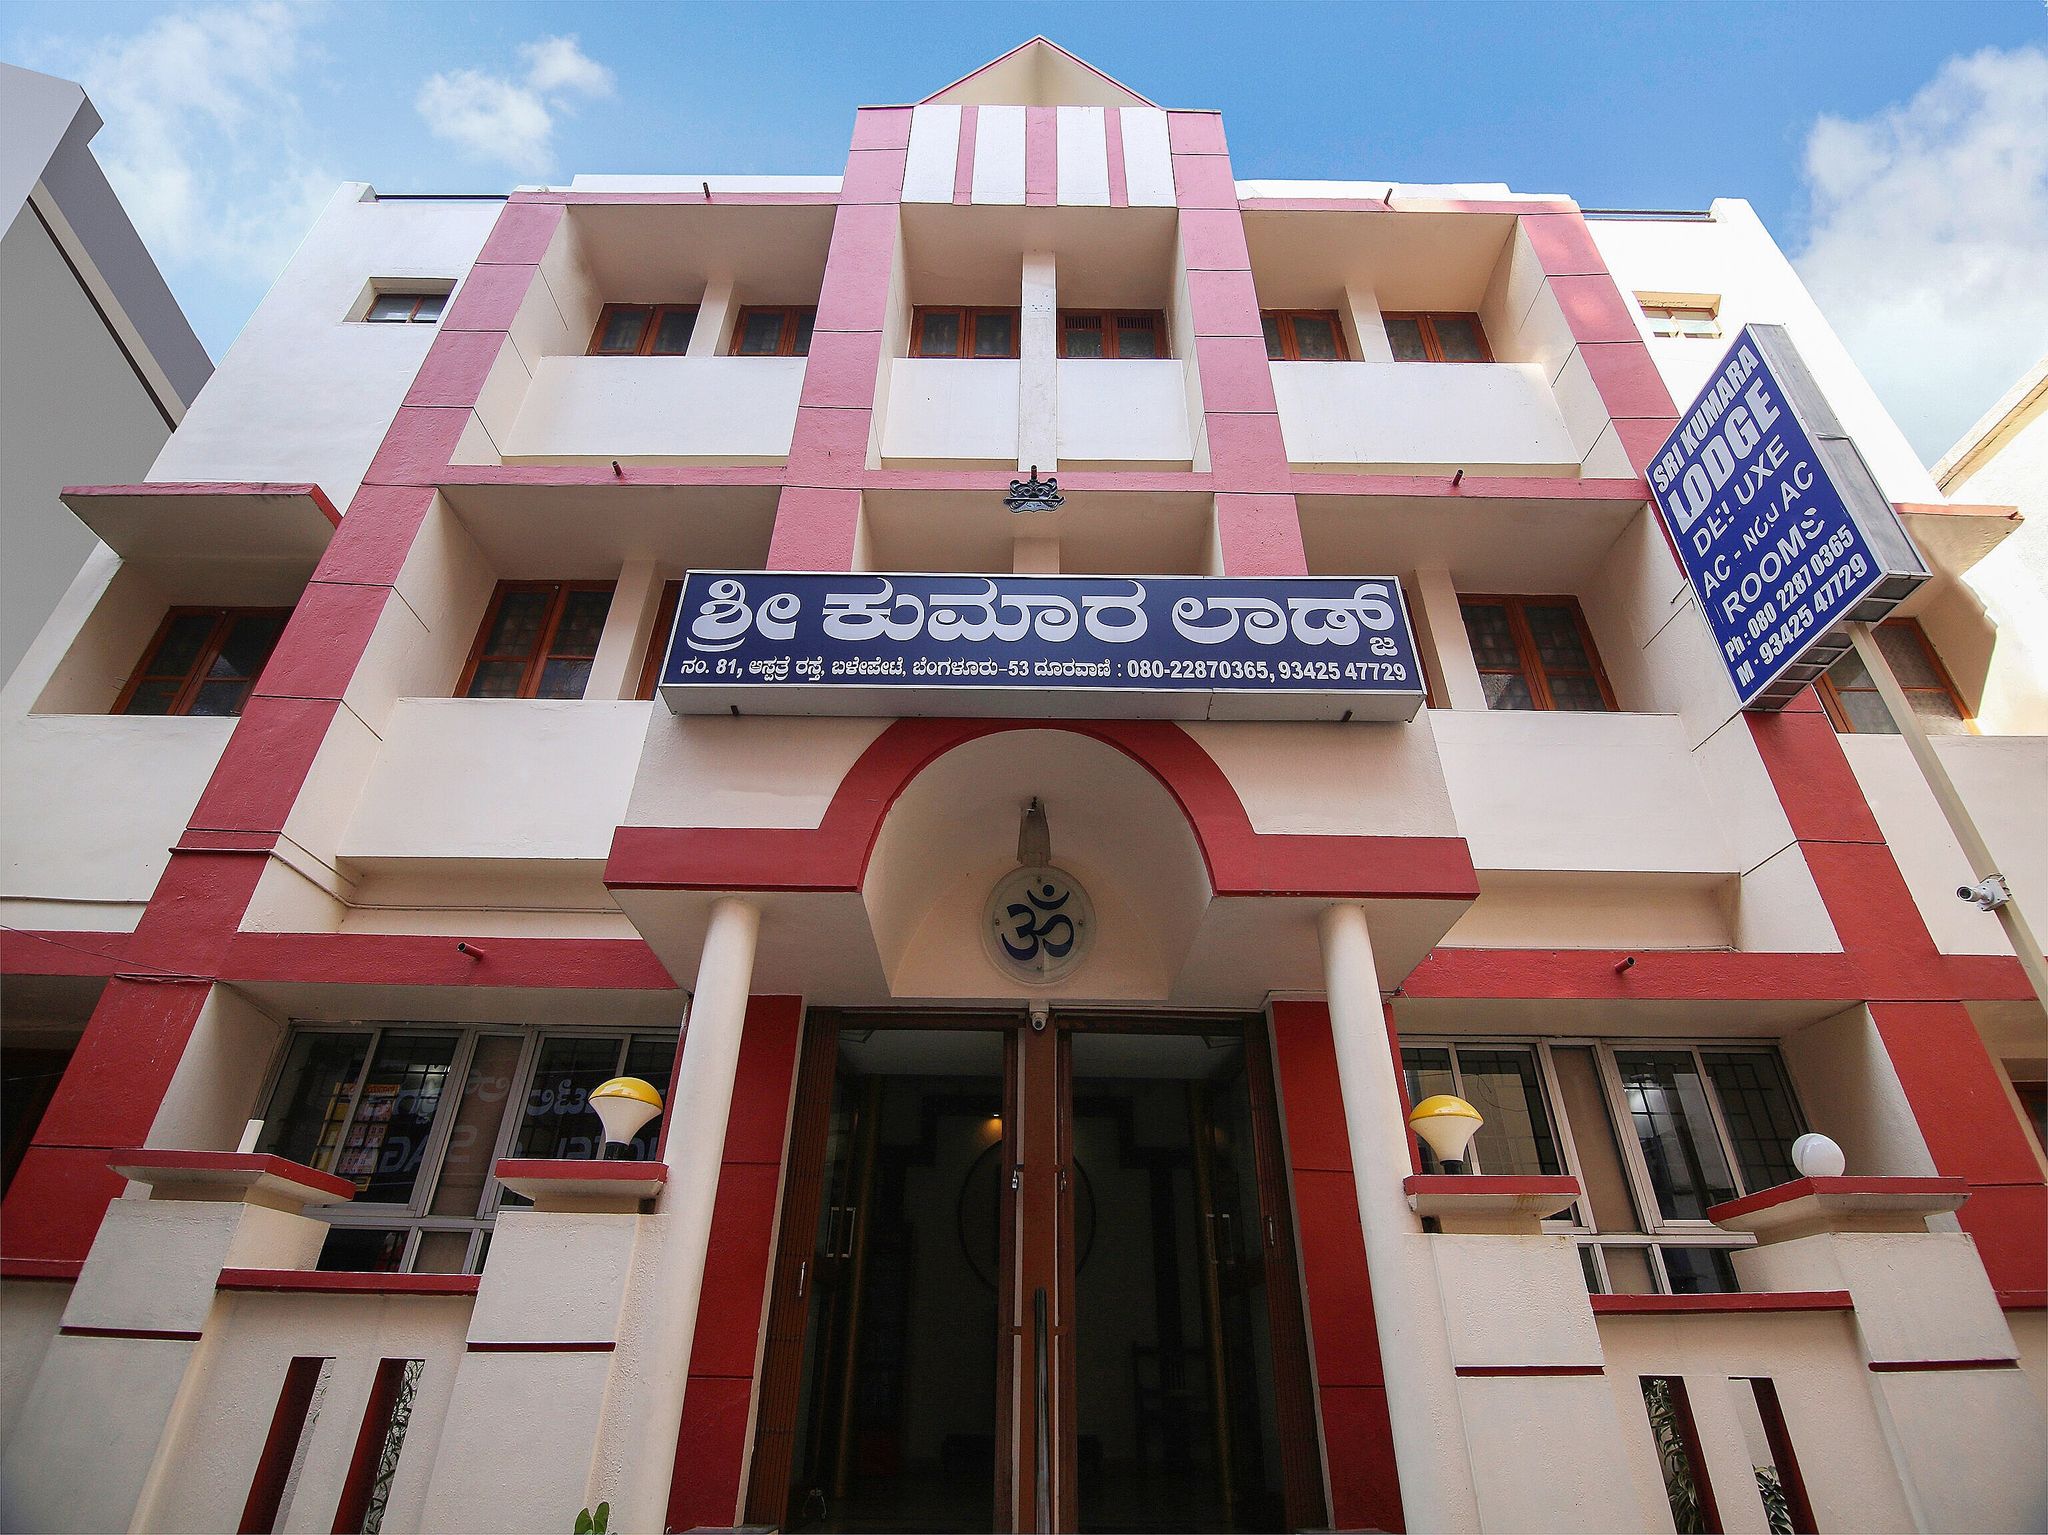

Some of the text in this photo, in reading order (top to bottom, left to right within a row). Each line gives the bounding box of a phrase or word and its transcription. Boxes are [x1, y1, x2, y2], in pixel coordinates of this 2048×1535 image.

[1653, 344, 1760, 493] SRI KUMARA
[1667, 376, 1781, 535] LODGE
[1703, 554, 1731, 599] AC
[1780, 461, 1814, 512] AC
[1775, 563, 1813, 612] 2287
[1809, 523, 1855, 577] 0365
[686, 577, 1399, 656] ಶ್ರೀ ಕುಮಾರ ಲಾಡ್ಜ್
[1758, 603, 1815, 665] 93425
[1813, 553, 1868, 614] 47729
[680, 656, 710, 675] ನಂ.
[715, 658, 743, 679] 81,
[795, 656, 825, 681] ರಸ್ತೆ,
[831, 656, 907, 678] ಬಳೇಪೇಟೆ,
[1034, 658, 1111, 677] ದೂರವಾಣಿ
[1127, 659, 1275, 684] 080-22870365,
[1278, 661, 1341, 681] 93425
[1344, 662, 1407, 681] 47729
